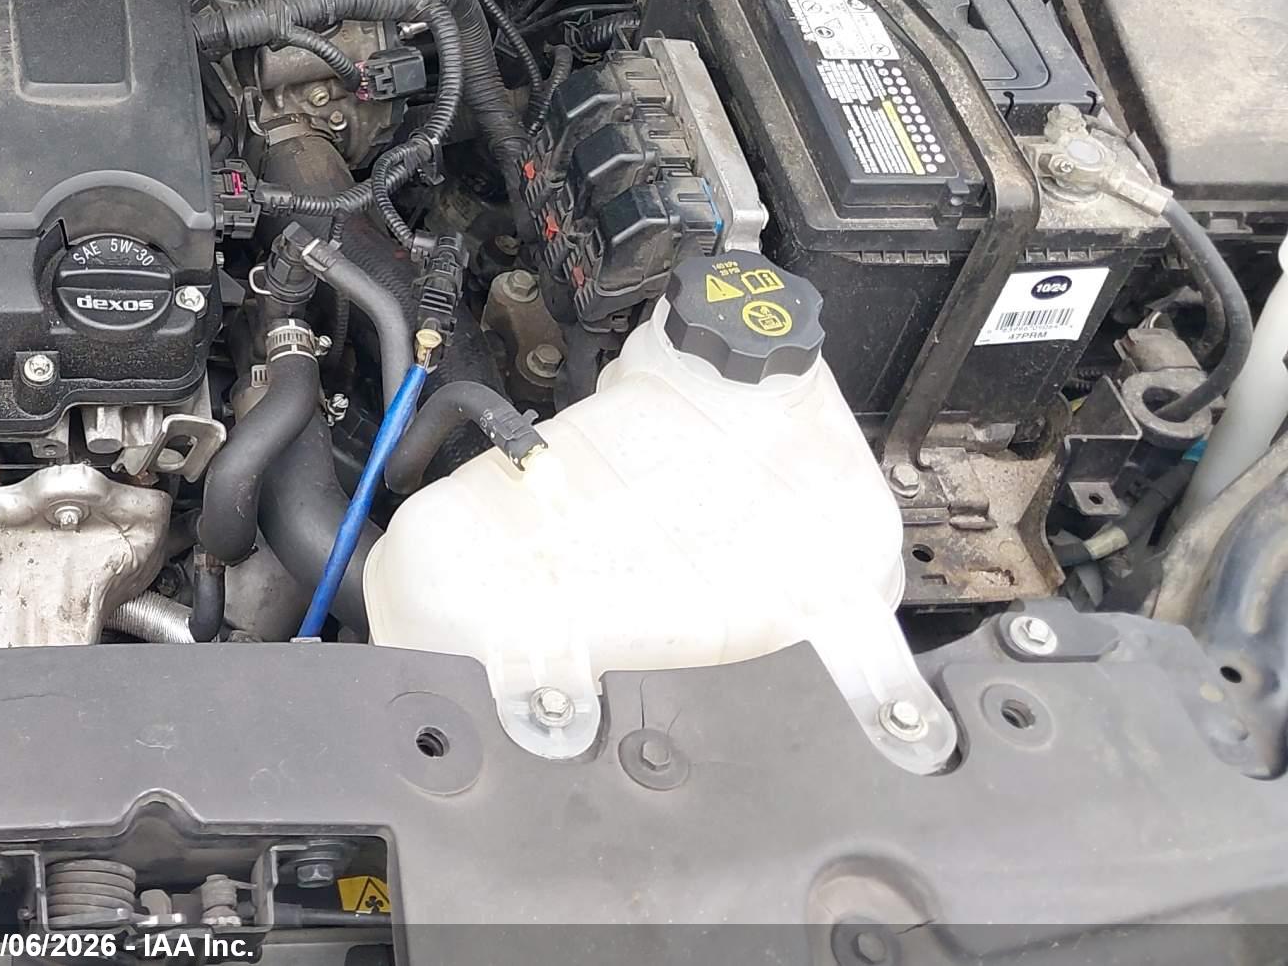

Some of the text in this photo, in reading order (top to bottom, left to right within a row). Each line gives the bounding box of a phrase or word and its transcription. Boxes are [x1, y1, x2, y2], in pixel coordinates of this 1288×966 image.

[73, 239, 154, 266] SAE 5W-30
[1036, 282, 1068, 293] 10/24
[76, 295, 154, 311] dexos
